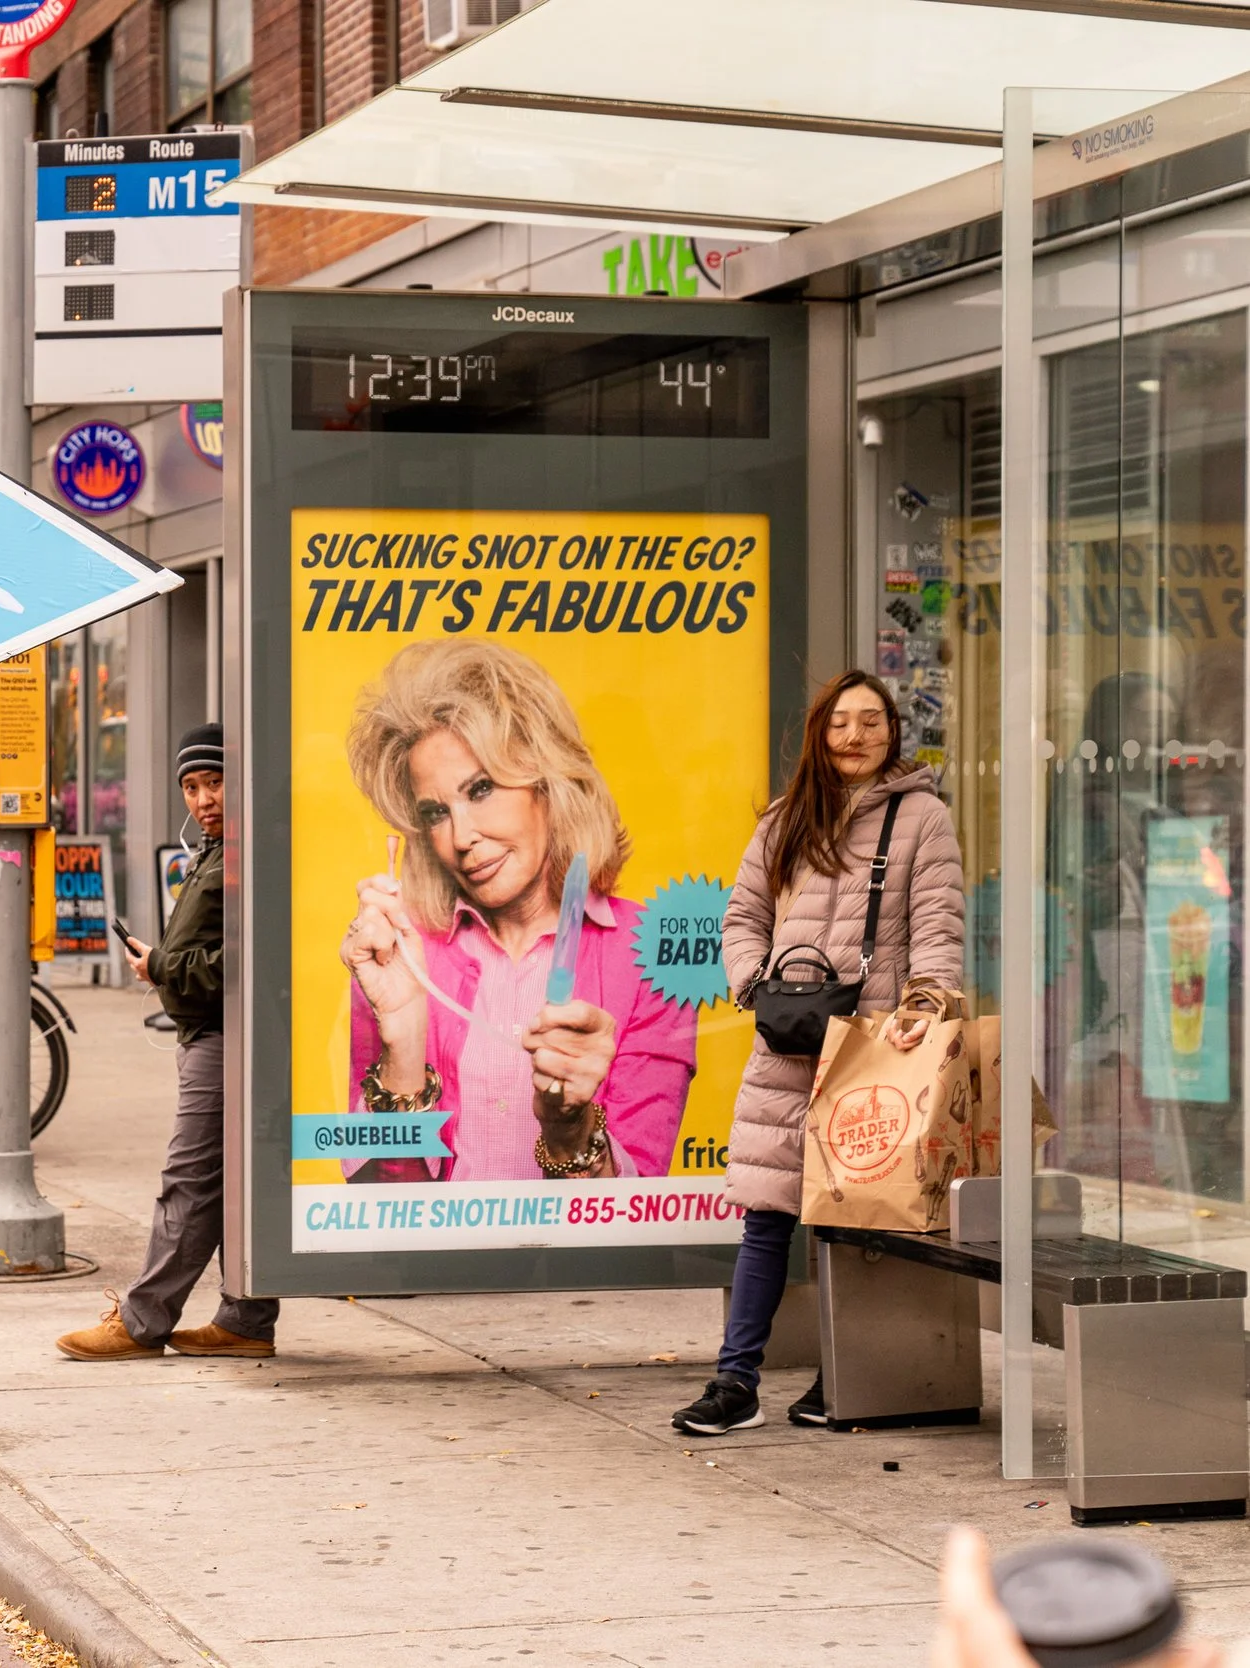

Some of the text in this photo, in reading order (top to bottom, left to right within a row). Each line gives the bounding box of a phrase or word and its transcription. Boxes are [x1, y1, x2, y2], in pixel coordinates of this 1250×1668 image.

[64, 139, 195, 163] Minutes Route
[1085, 133, 1101, 155] NO
[1103, 114, 1154, 149] SMOKING
[93, 176, 116, 211] 2
[148, 169, 227, 211] M15
[492, 306, 575, 324] JCDecaux
[348, 353, 461, 402] 12:39
[59, 425, 139, 465] CITY HOPS
[301, 533, 757, 572] SUCKING SNOT ON THE GO?
[302, 579, 756, 634] THAT'S FABULOUS
[55, 846, 102, 873] OPPY
[660, 917, 689, 935] FOR
[314, 1125, 422, 1152] @SUEBELLE
[838, 1118, 900, 1147] TRADER
[846, 1136, 890, 1160] JOE'S
[305, 1200, 370, 1231] CALL
[376, 1200, 426, 1230] THE
[429, 1195, 564, 1228] SNOTLINE!
